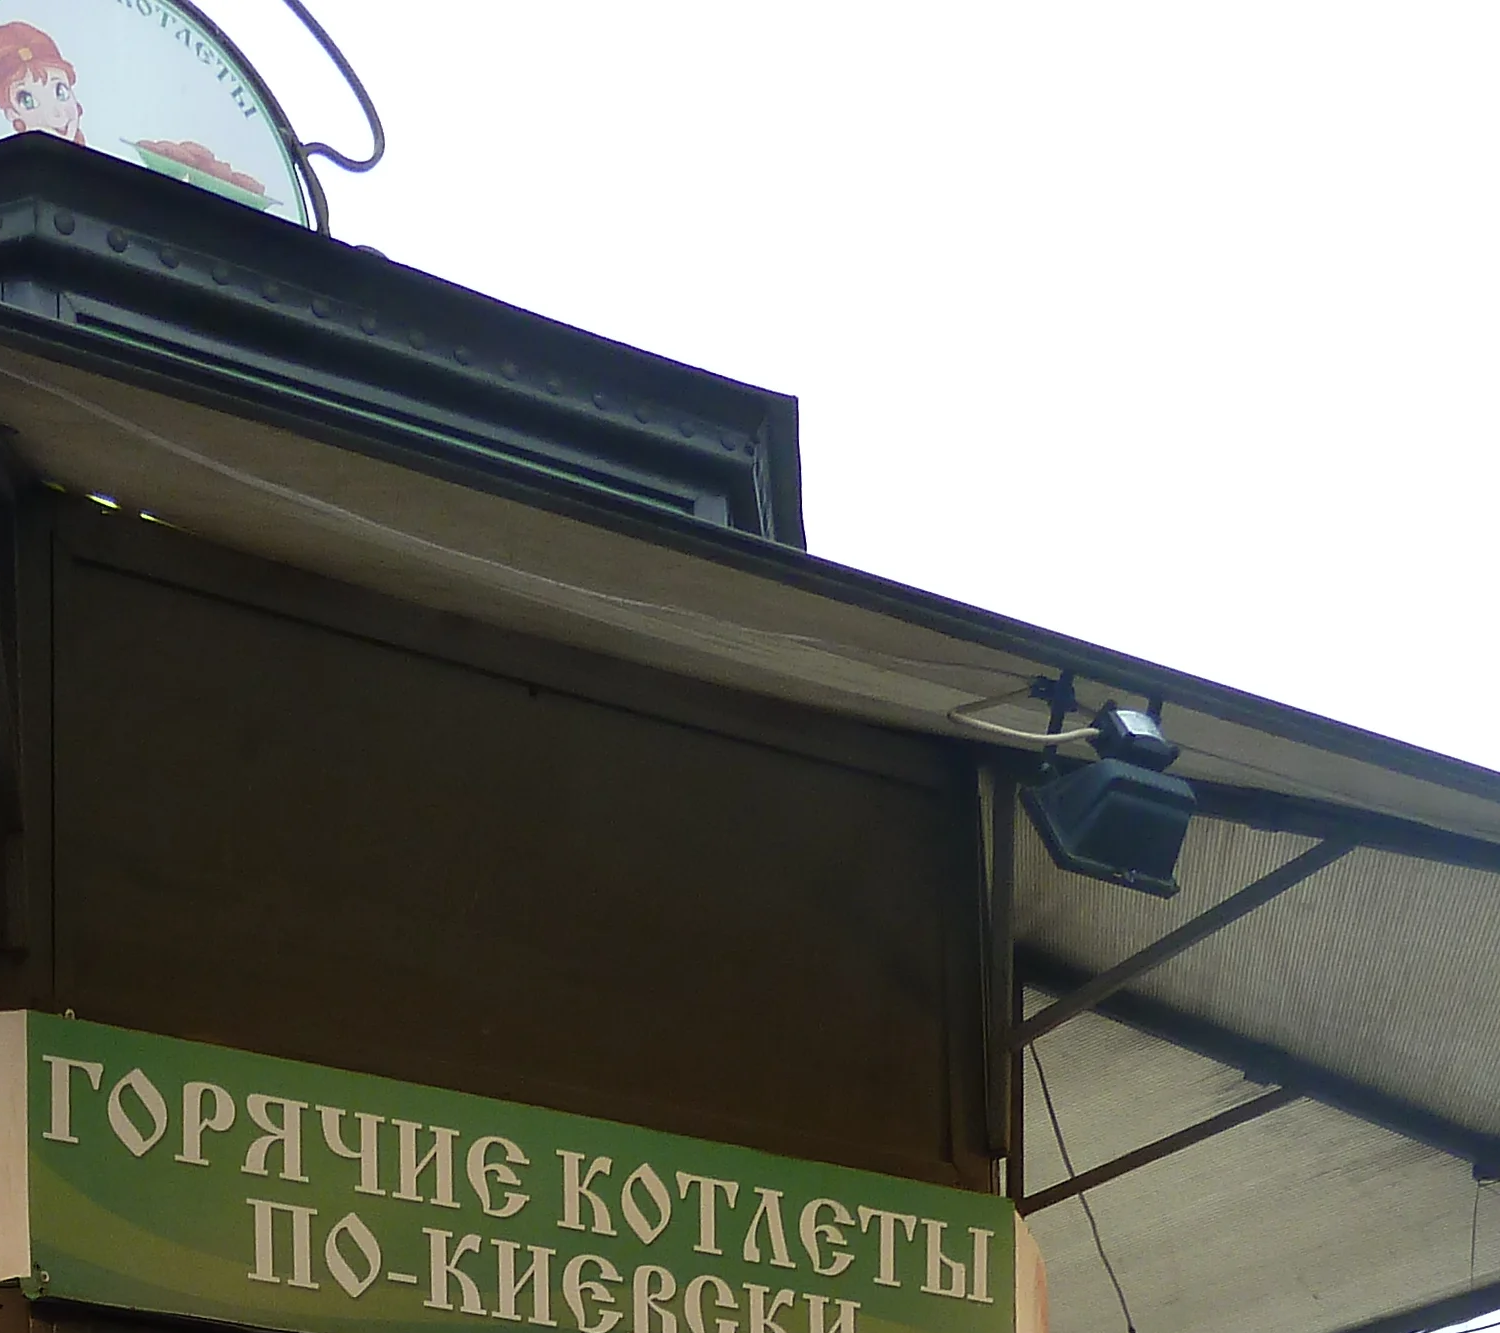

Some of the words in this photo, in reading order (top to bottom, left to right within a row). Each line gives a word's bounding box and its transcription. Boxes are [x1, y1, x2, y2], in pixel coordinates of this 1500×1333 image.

[116, 0, 258, 119] ОТЛЕТЫ
[41, 1053, 530, 1218] ГОРЯЧИЕ
[555, 1148, 994, 1304] КОТЛЕТЫ
